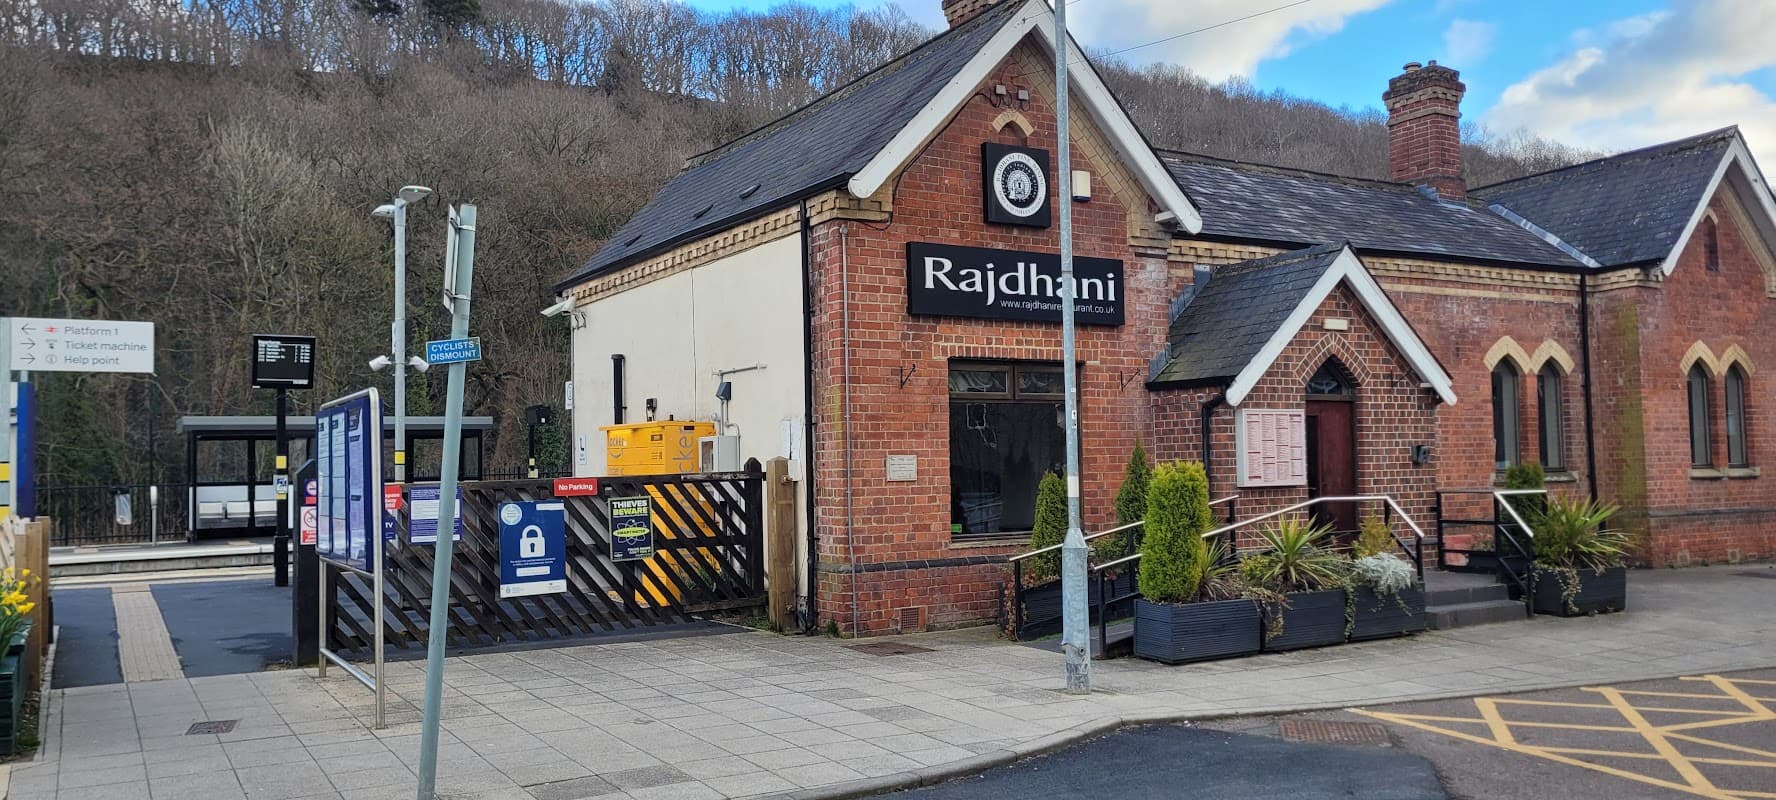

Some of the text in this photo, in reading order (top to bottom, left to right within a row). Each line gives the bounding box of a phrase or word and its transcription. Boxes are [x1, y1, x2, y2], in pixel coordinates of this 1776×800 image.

[1000, 299, 1116, 314] www.rajdhanireurant.co.uk
[64, 325, 119, 336] Platform 1
[65, 340, 147, 352] Ticket machine
[431, 341, 474, 352] CYCLISTS
[64, 355, 120, 366] Help point
[430, 350, 477, 361] DISMOUNT
[569, 483, 593, 491] Parking
[612, 500, 648, 509] THIEVES
[612, 507, 649, 516] BEWARE
